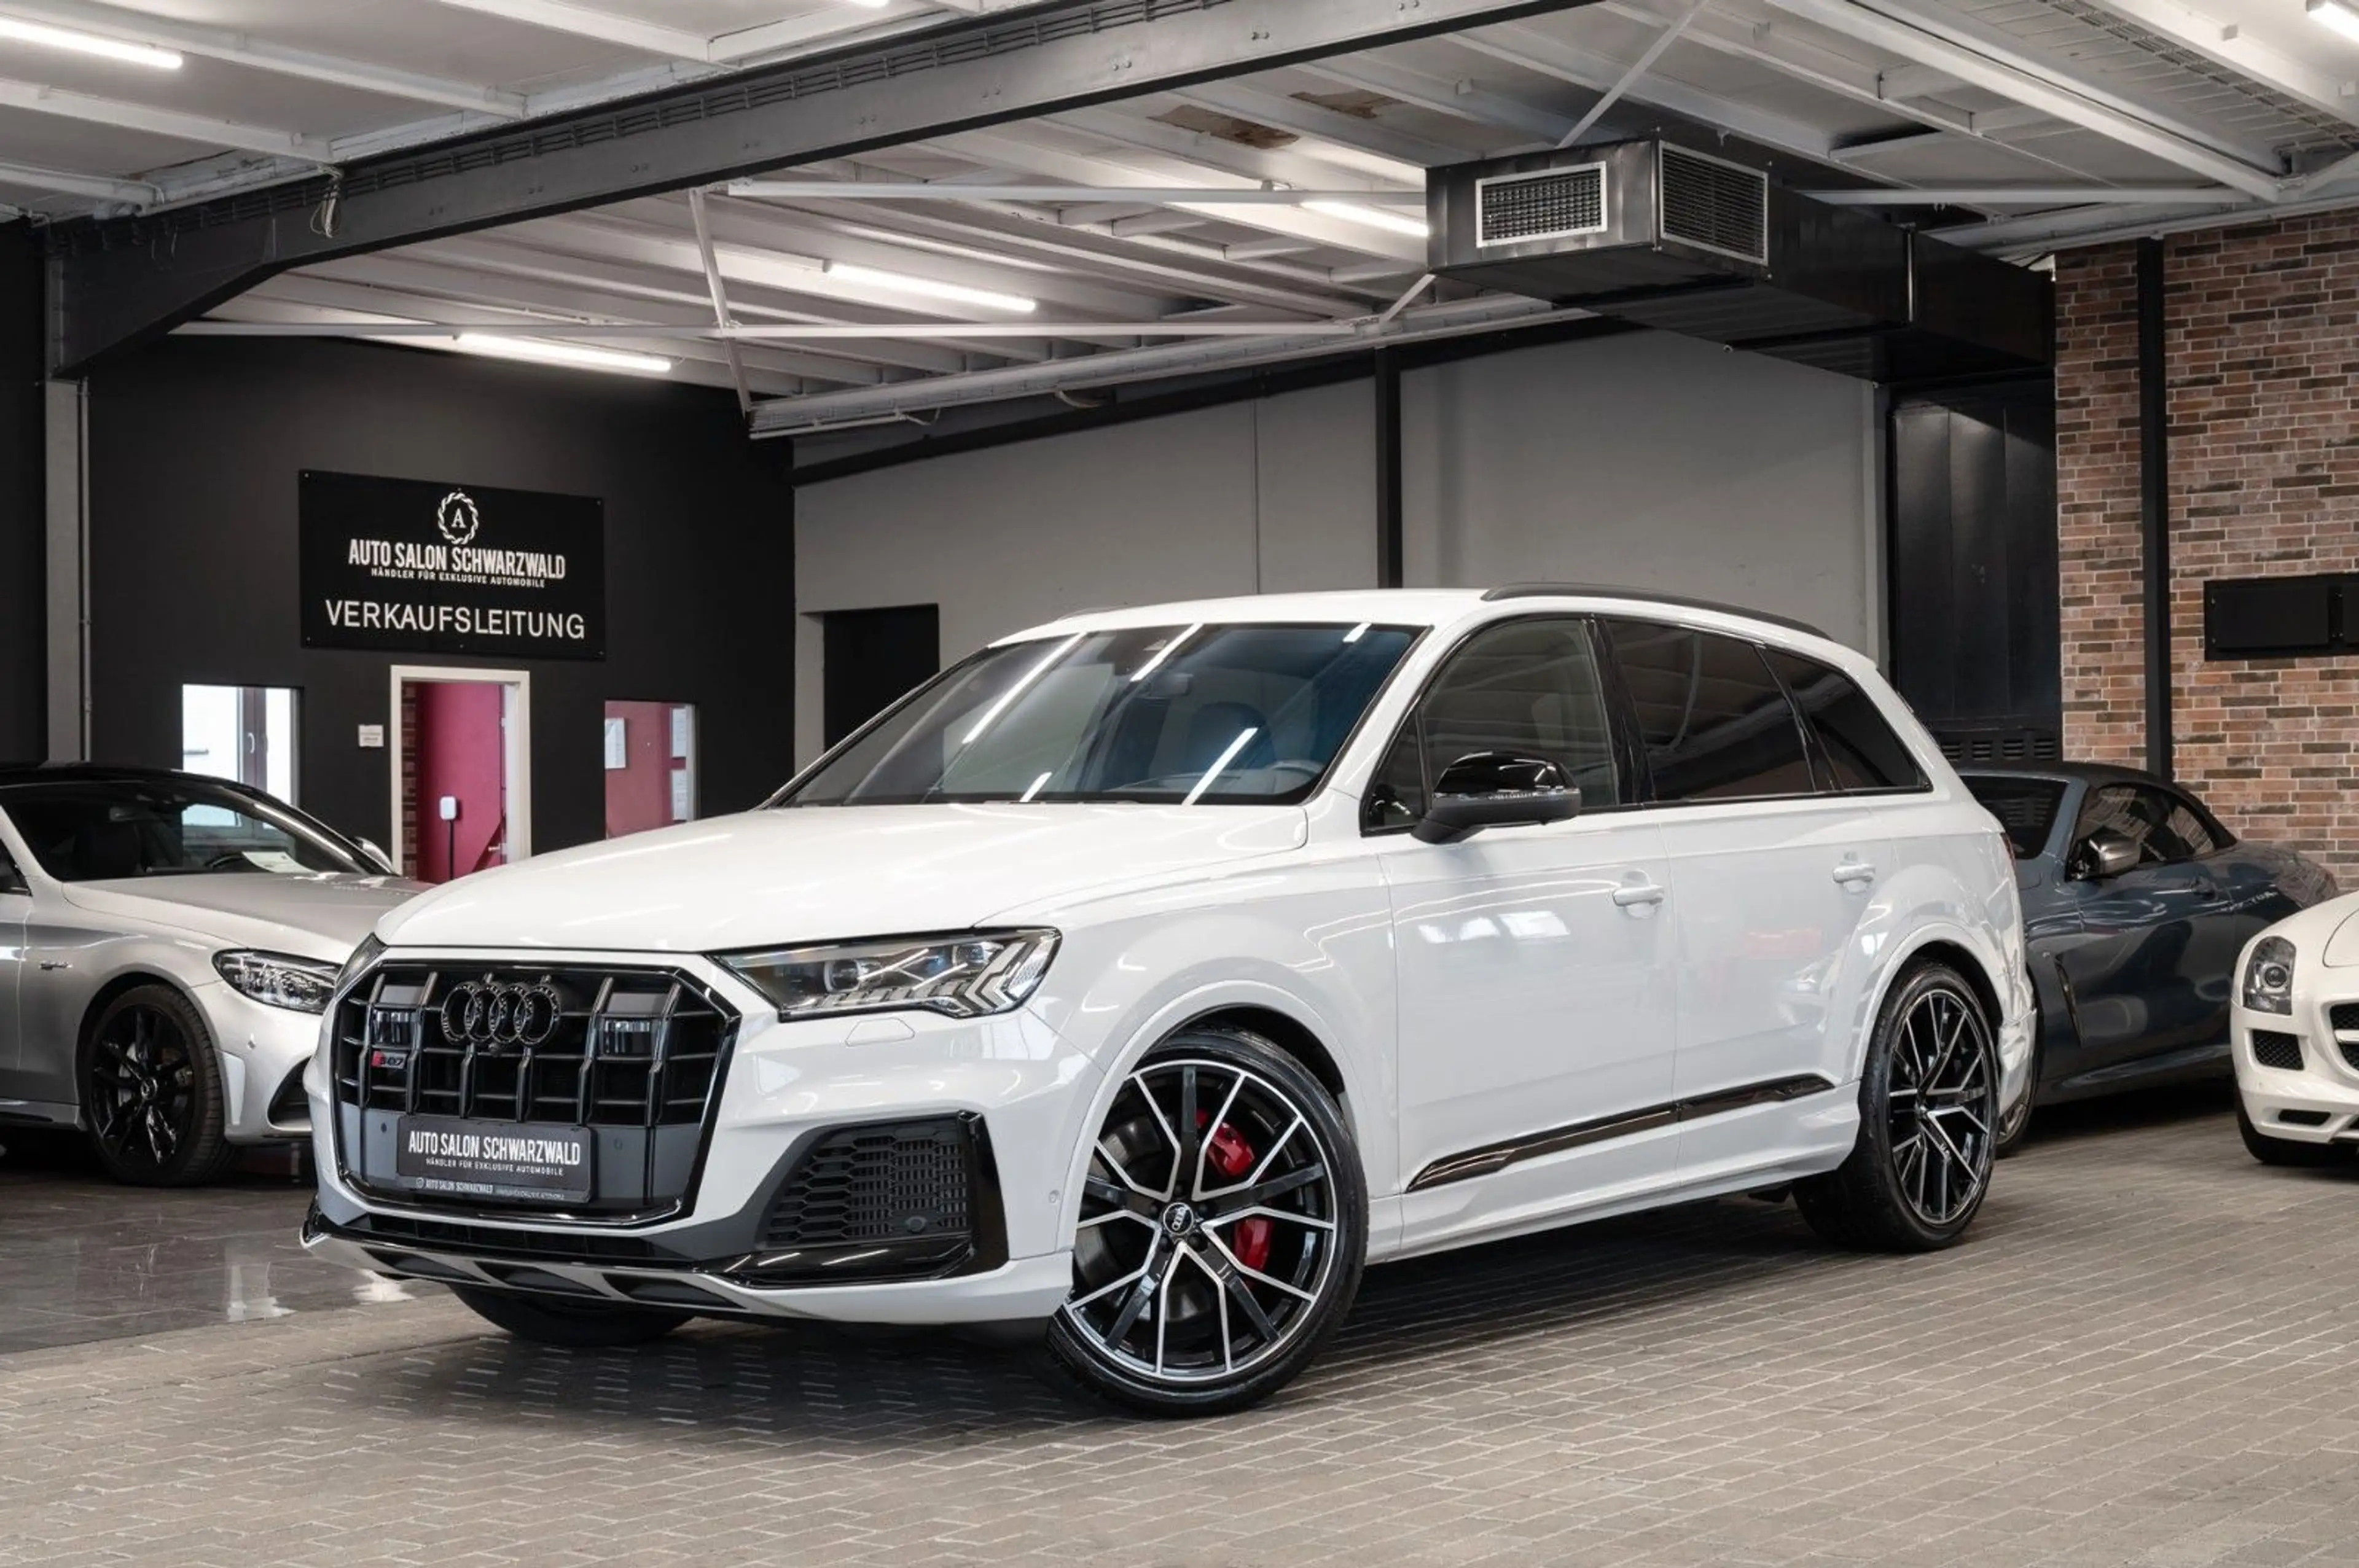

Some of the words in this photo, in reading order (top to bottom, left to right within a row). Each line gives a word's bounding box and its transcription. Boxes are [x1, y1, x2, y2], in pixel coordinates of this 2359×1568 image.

[451, 508, 466, 528] A
[348, 539, 391, 568] AUTO
[394, 542, 447, 571] SALON
[452, 547, 566, 580] SCHWARZWALD
[439, 574, 488, 584] EXKLUSIVE
[491, 577, 546, 588] AUTOMOBILE
[326, 599, 585, 639] VERKAUFSLEITUNG
[409, 1131, 438, 1155] AUTO
[440, 1133, 480, 1158] SALON
[483, 1136, 581, 1166] SCHWARZWALD
[474, 1161, 514, 1172] EXKLUSIVE
[516, 1166, 564, 1176] AUTOMOBILE
